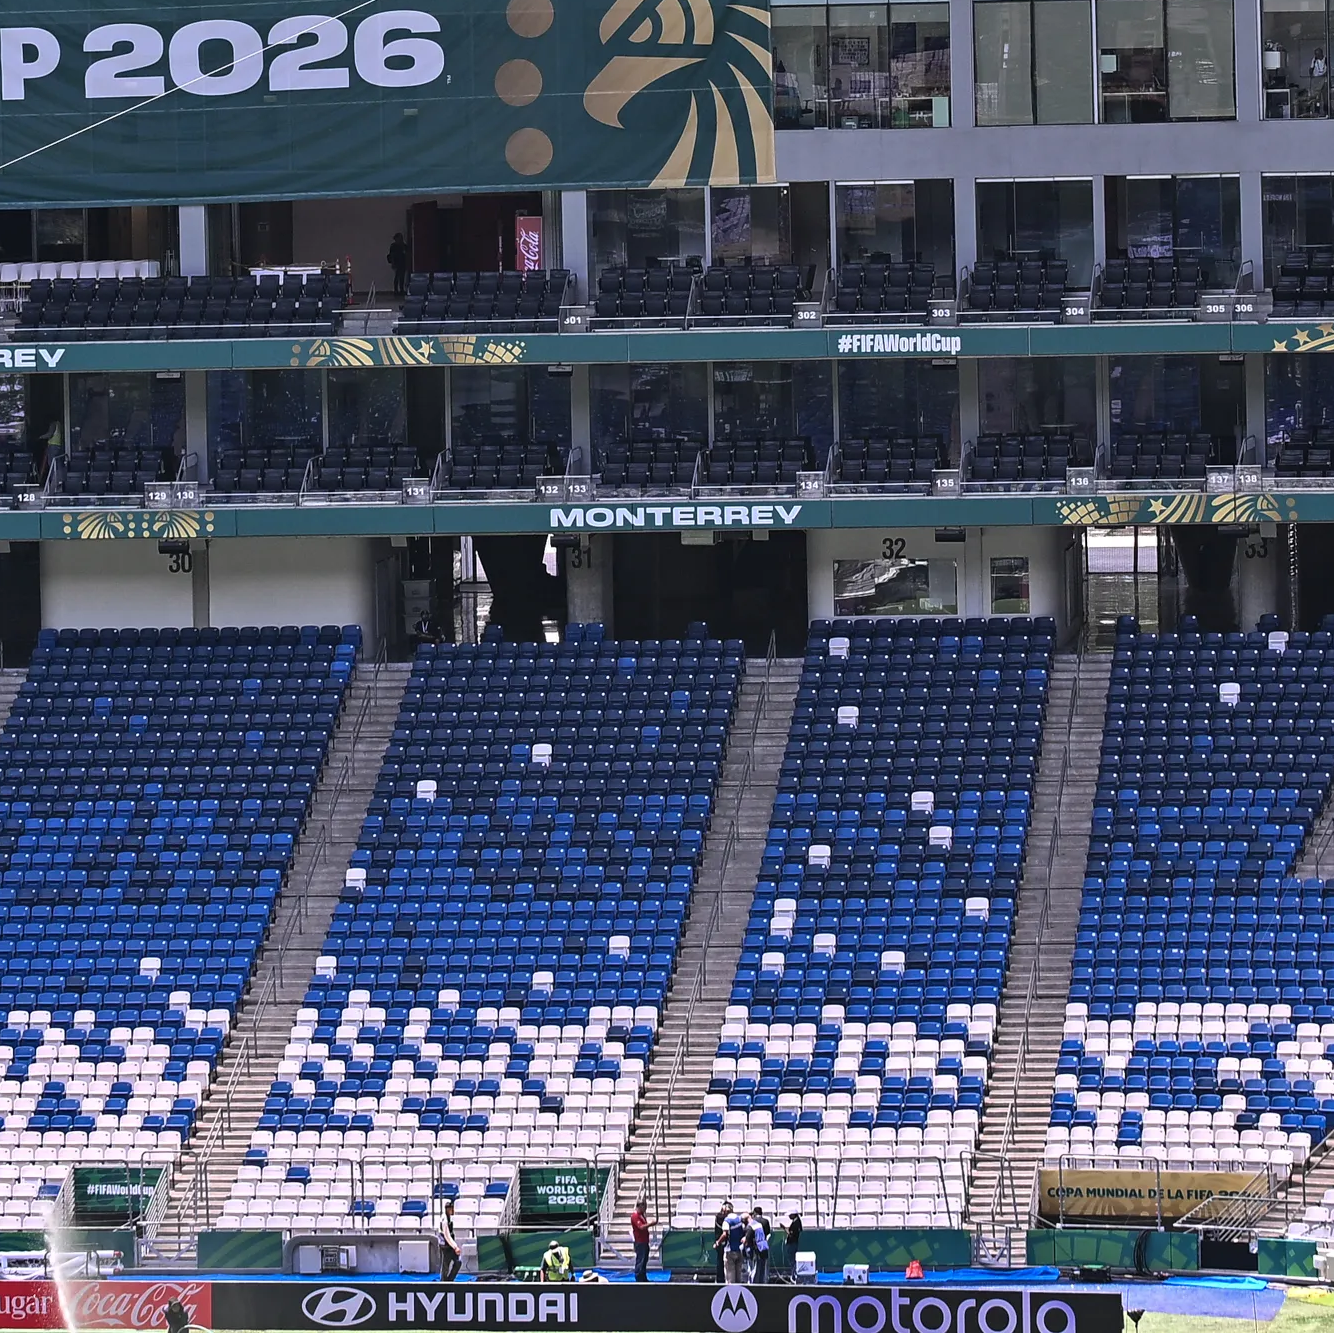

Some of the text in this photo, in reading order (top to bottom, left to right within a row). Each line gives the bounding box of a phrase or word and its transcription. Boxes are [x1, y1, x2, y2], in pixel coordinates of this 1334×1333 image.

[84, 9, 446, 100] 2026
[1065, 308, 1084, 316] 304
[1207, 305, 1225, 313] 305
[1235, 304, 1252, 312] 306
[797, 311, 815, 319] 302
[932, 309, 950, 318] 303
[837, 332, 961, 356] #FIFAWorldCup
[936, 479, 954, 487] 135
[1070, 478, 1088, 486] 136
[1210, 476, 1227, 484] 137
[1239, 475, 1257, 483] 138
[540, 486, 558, 494] 132
[568, 485, 586, 493] 133
[800, 481, 818, 490] 134
[148, 492, 166, 500] 129
[176, 491, 194, 499] 130
[407, 487, 424, 496] 131
[18, 493, 35, 502] 128
[550, 505, 802, 528] MONTERREY
[882, 538, 906, 559] 32
[572, 546, 591, 568] 31
[169, 552, 192, 573] 30
[555, 1176, 578, 1184] FIFA
[537, 1185, 575, 1194] WORLD
[1047, 1187, 1083, 1198] COPA
[1087, 1188, 1145, 1199] MUNDIAL
[1148, 1189, 1164, 1198] DE
[1167, 1189, 1184, 1200] LA
[1187, 1190, 1214, 1200] FIFA
[548, 1195, 585, 1205] 2026
[388, 1292, 578, 1323] HYUNDAI
[787, 1287, 1077, 1333] motorola
